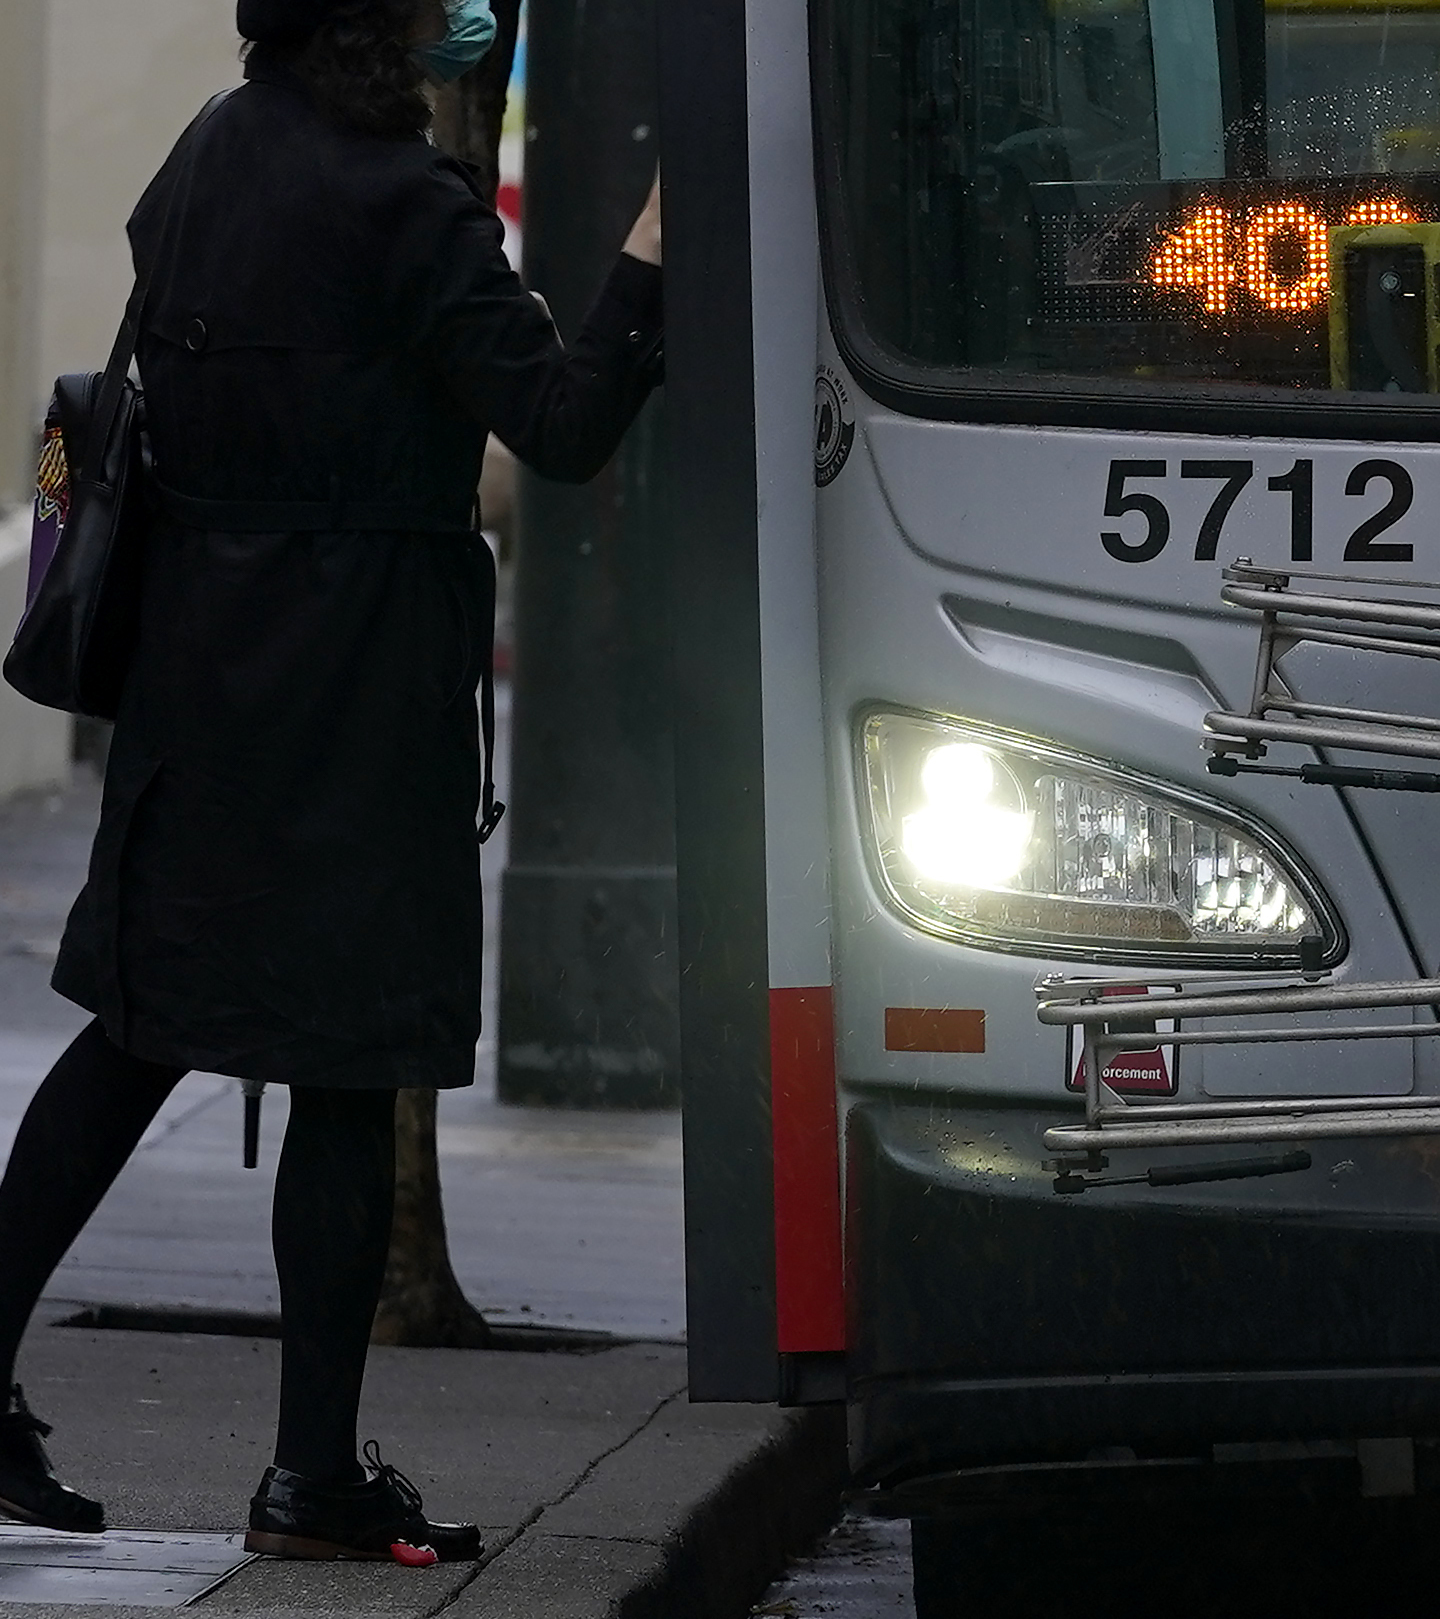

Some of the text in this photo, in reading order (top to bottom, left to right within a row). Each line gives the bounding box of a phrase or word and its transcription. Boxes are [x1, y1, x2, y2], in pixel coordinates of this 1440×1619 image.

[1150, 200, 1418, 312] 40
[1100, 458, 1415, 563] 5712
[1082, 1062, 1162, 1080] orcement
